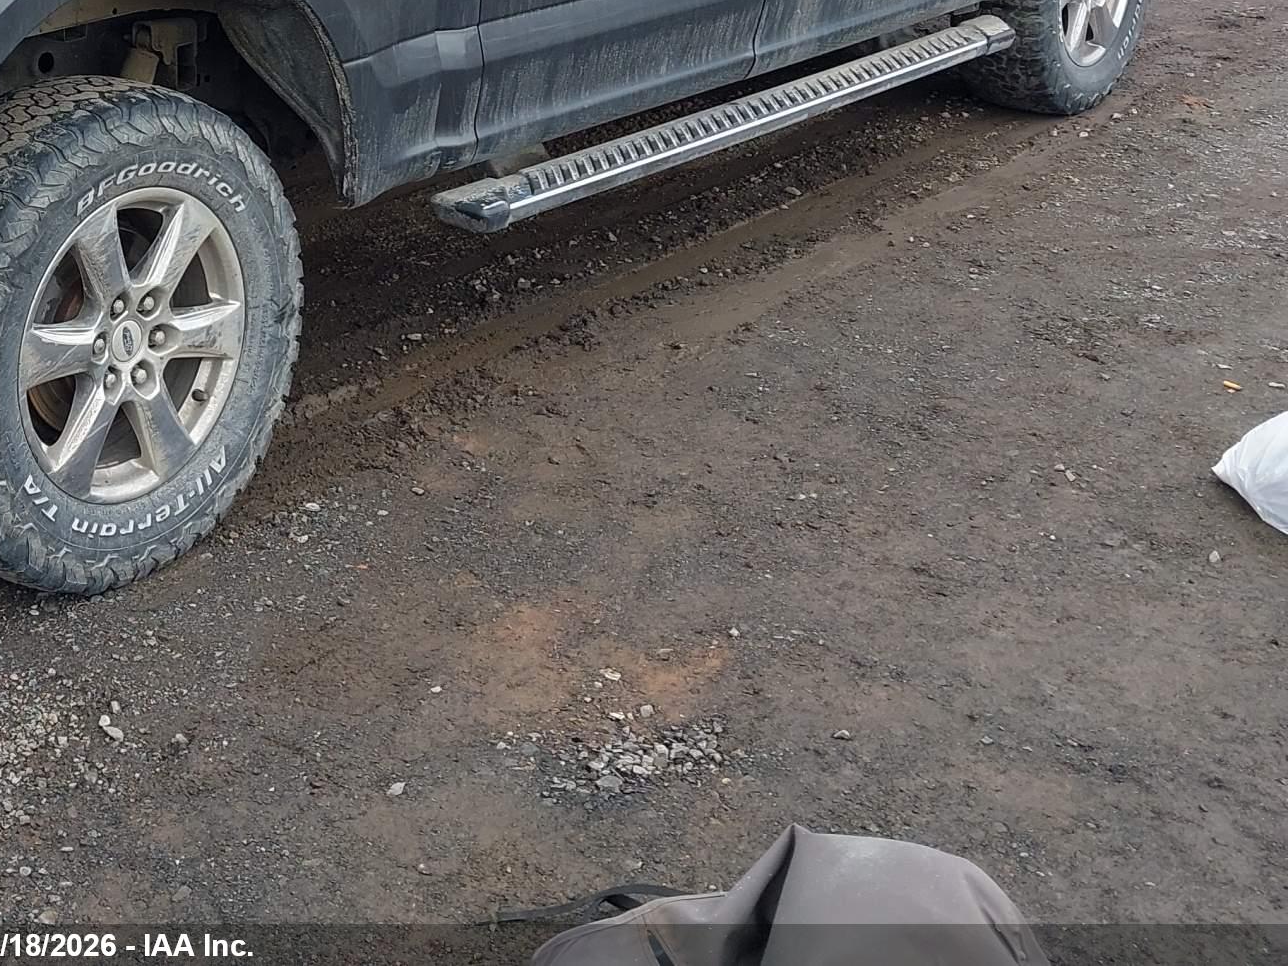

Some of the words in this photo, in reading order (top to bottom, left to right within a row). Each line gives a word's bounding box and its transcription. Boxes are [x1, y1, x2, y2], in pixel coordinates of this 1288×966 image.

[75, 160, 247, 217] BFGoodrich
[23, 473, 58, 522] T/A
[71, 444, 227, 539] All-Terrain
